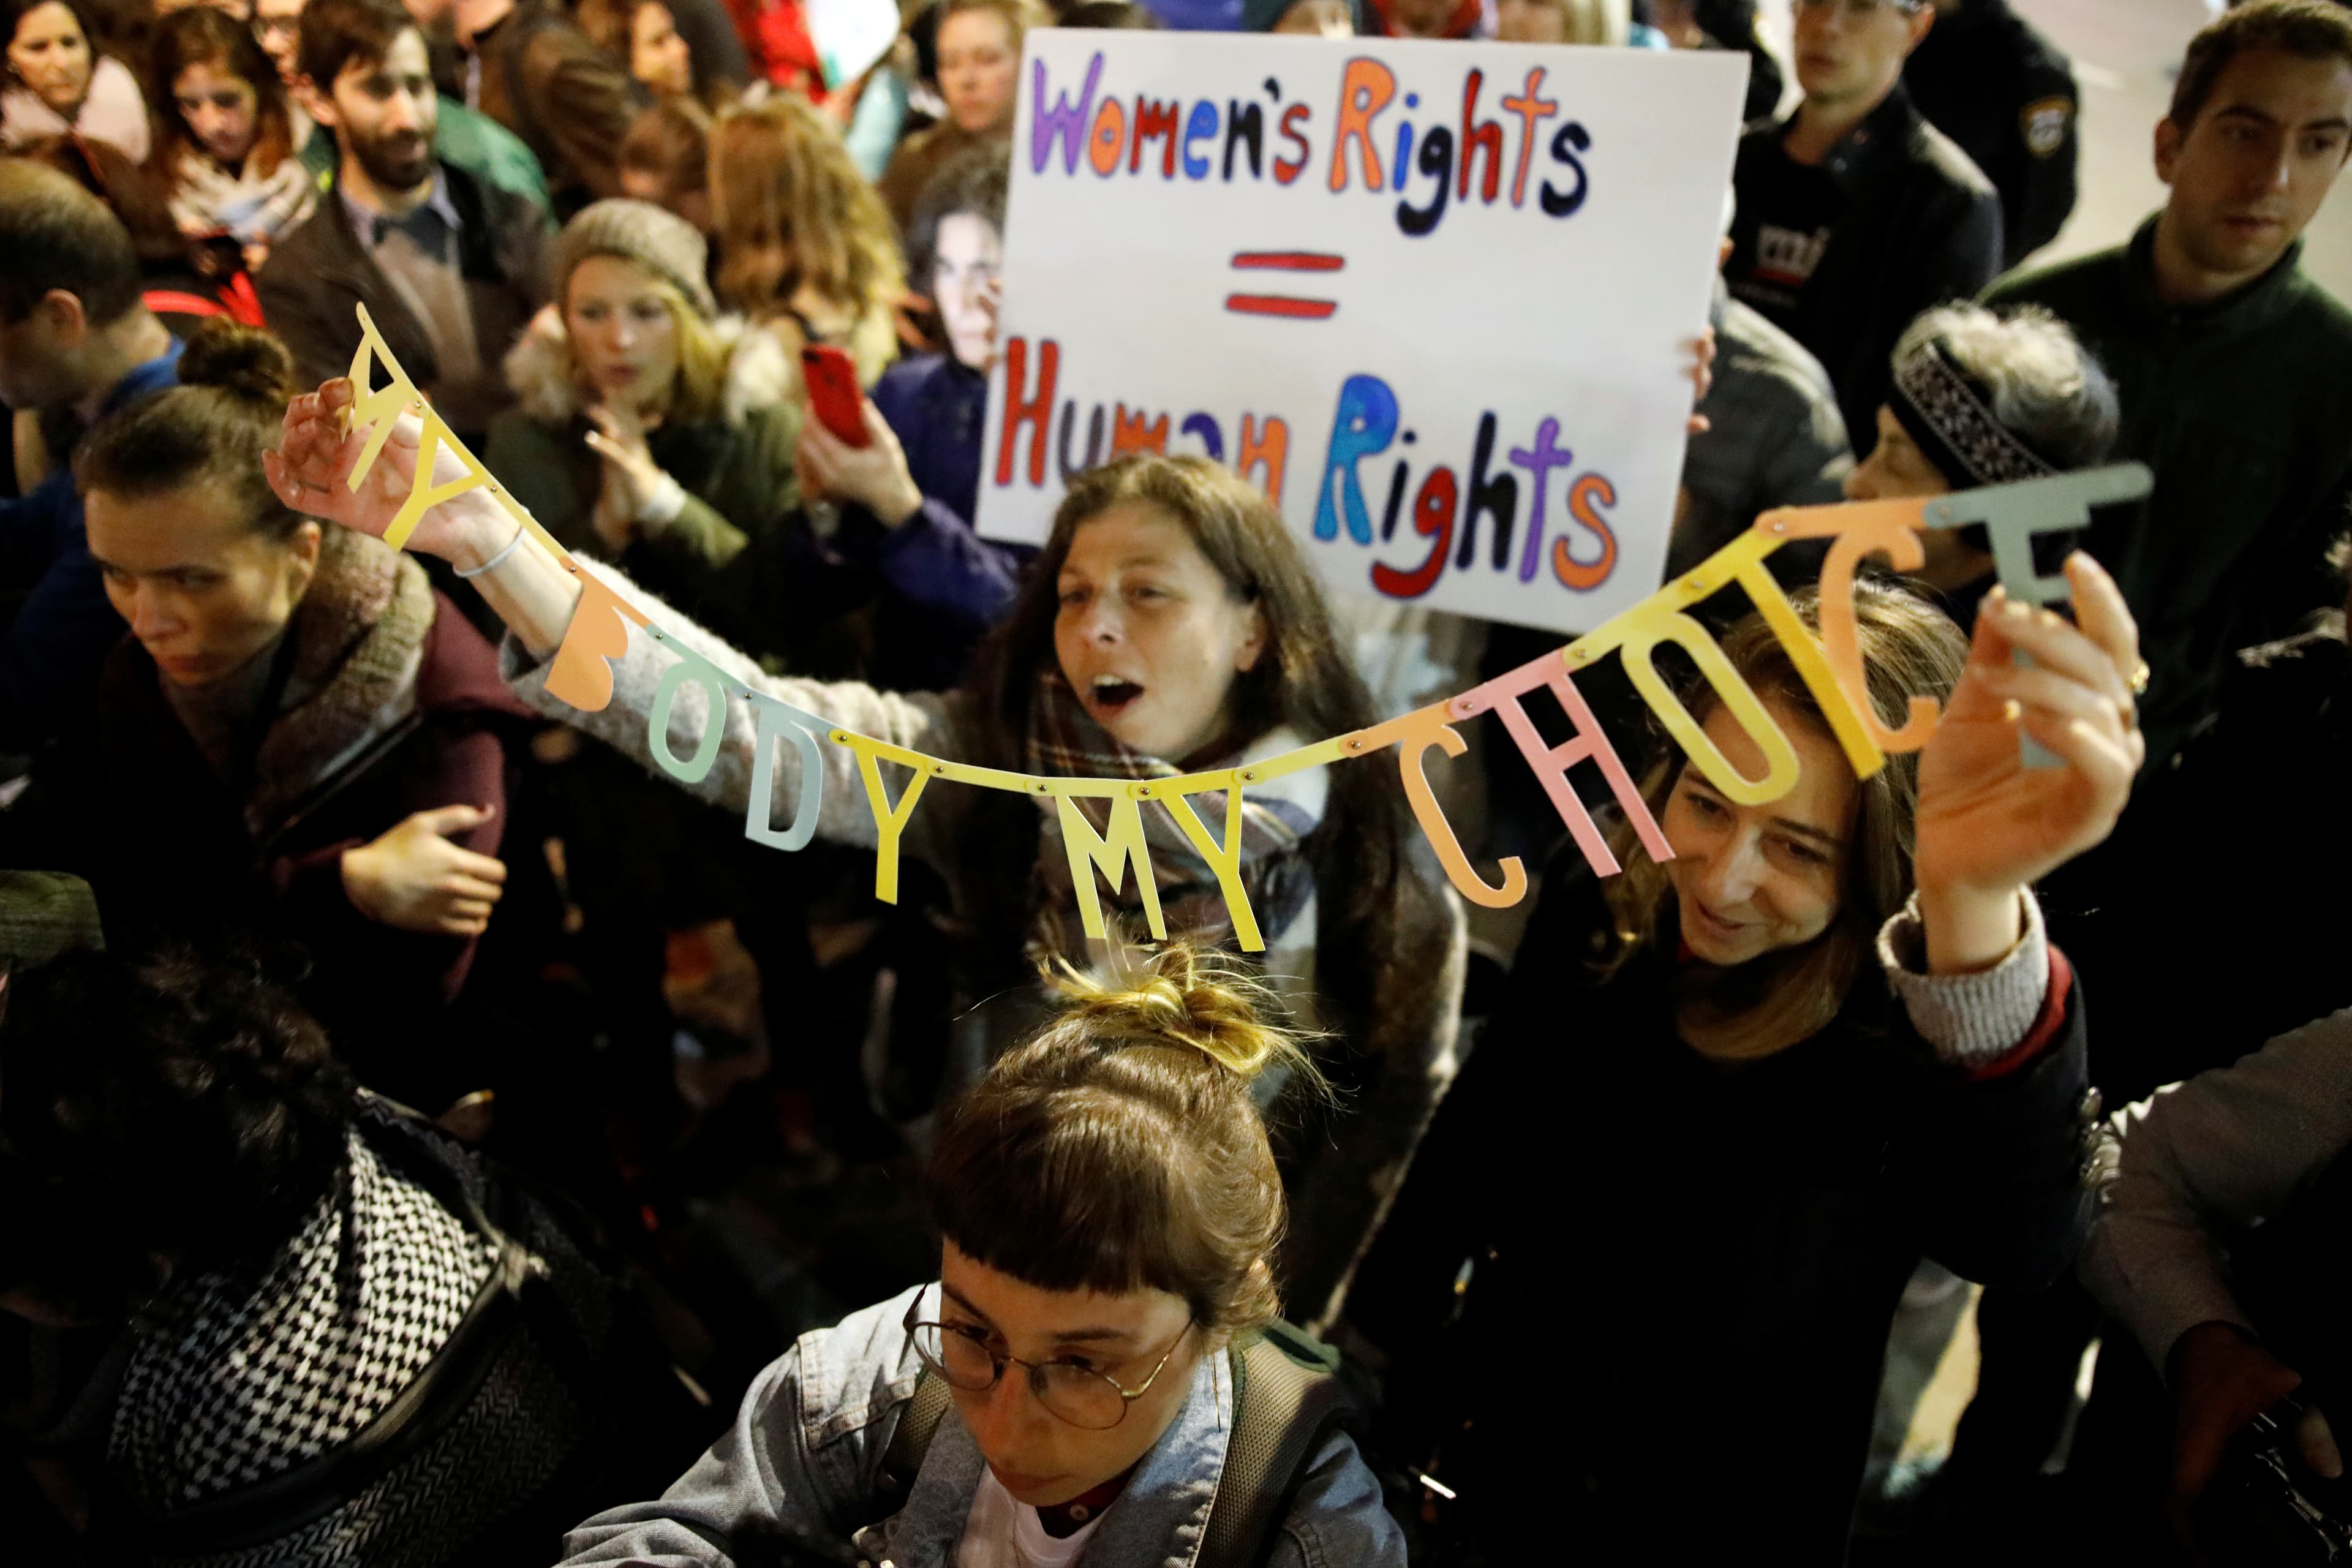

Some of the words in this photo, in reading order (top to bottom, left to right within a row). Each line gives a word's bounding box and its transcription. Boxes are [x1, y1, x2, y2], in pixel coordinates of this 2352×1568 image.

[1031, 51, 1311, 185] Women's
[1328, 56, 1591, 237] Rights
[1313, 373, 1618, 600] Rights
[545, 567, 931, 905] BODY
[1054, 777, 1266, 952] MY
